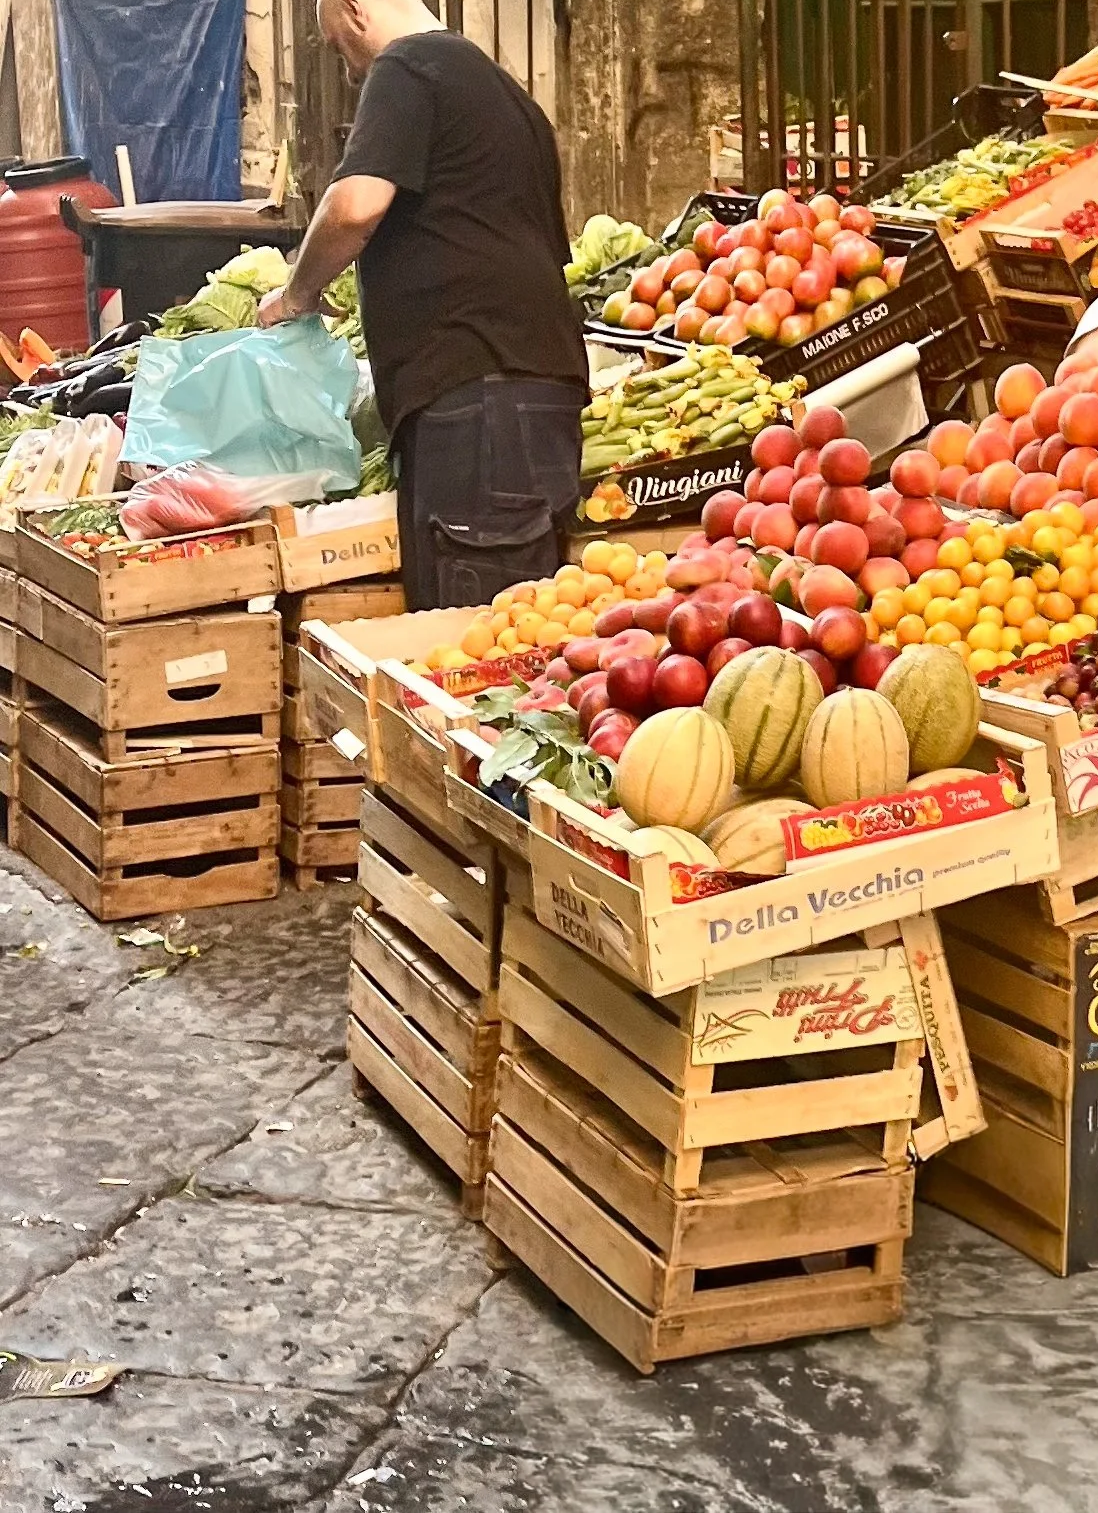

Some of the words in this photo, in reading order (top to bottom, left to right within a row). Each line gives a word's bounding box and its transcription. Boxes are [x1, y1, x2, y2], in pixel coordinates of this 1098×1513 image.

[802, 323, 851, 359] MAIONE
[852, 302, 889, 332] F.SCO
[627, 460, 743, 506] Vingiani
[320, 542, 381, 565] Della
[550, 881, 590, 923] DELLA
[709, 904, 800, 944] Della
[806, 863, 925, 914] Vecchia
[920, 974, 951, 1074] PESQUITA
